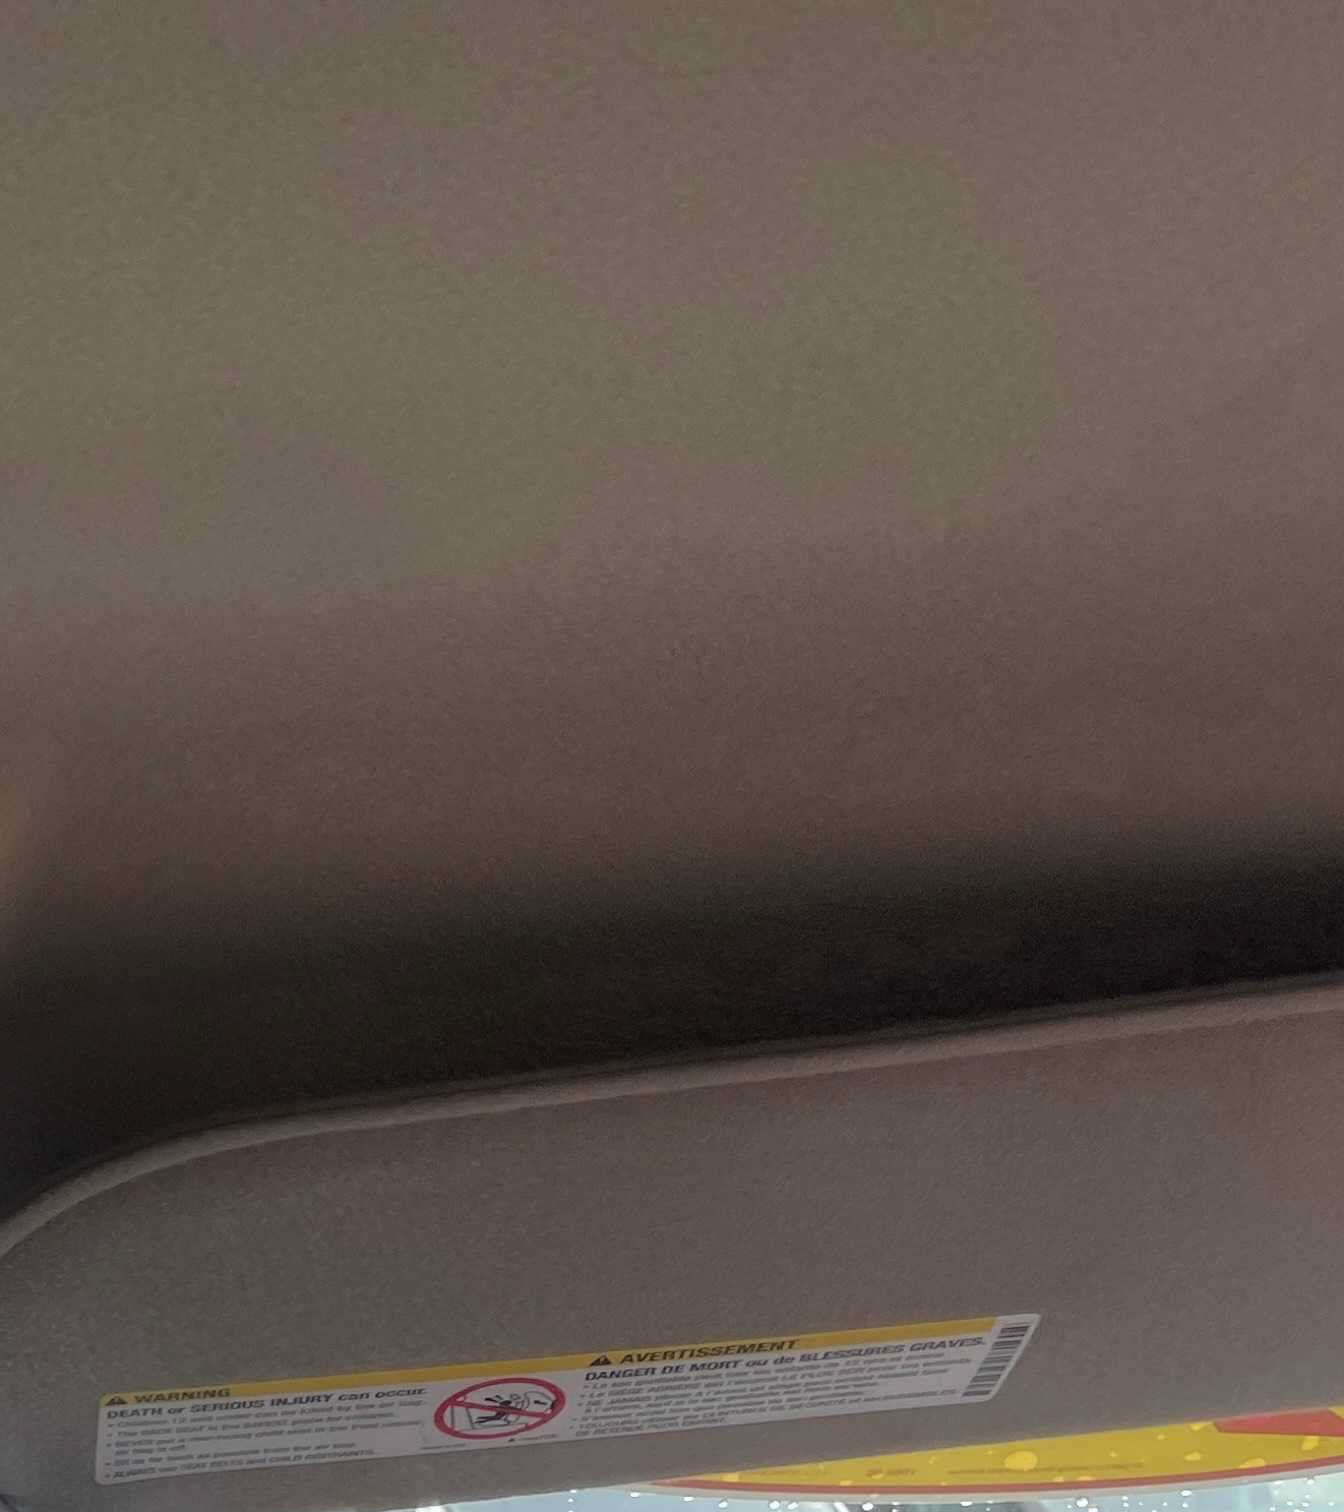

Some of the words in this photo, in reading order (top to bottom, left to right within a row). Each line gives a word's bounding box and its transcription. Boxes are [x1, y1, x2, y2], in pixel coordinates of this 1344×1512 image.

[584, 1366, 657, 1381] DANGER
[661, 1363, 686, 1376] DE
[689, 1358, 742, 1372] MORT
[798, 1343, 906, 1363] BLESSURES
[619, 1339, 800, 1365] AVERTISSEMENT
[106, 1405, 163, 1420] DEATH
[167, 1407, 185, 1417] or
[189, 1399, 265, 1416] SERIOUS
[269, 1392, 332, 1408] INJURY
[336, 1391, 370, 1402] can
[134, 1387, 231, 1404] WARNING
